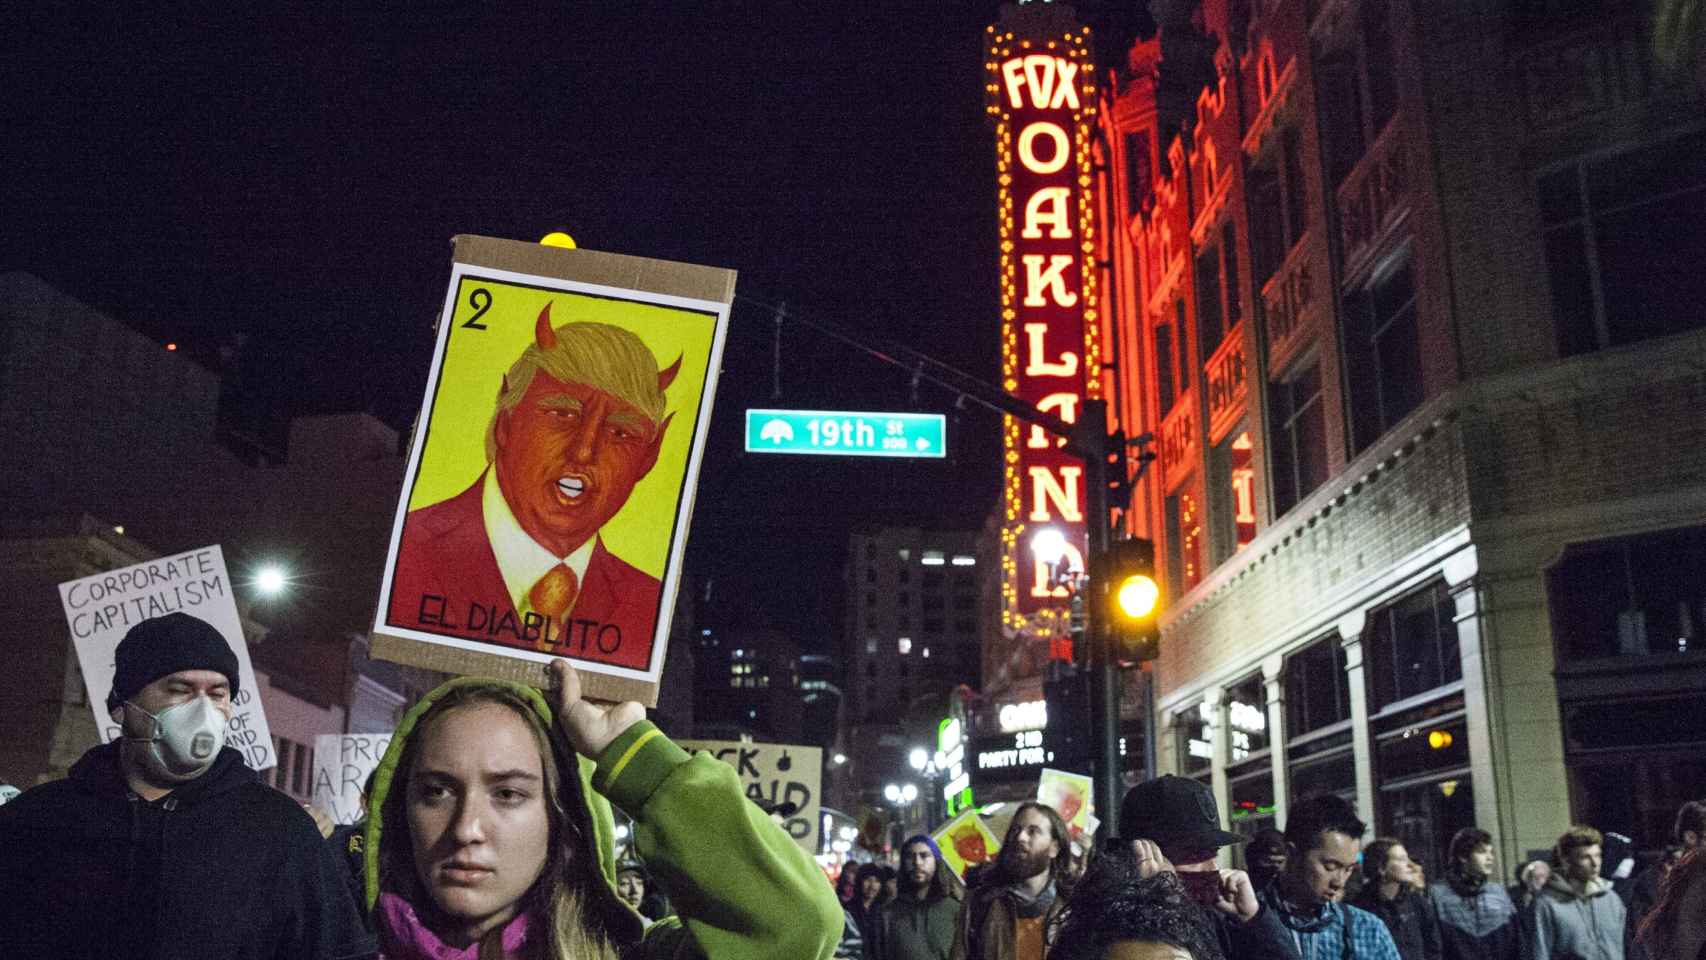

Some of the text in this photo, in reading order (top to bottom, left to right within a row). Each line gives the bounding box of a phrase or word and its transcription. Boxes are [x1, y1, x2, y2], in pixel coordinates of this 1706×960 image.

[1002, 54, 1080, 109] FOX
[461, 288, 492, 331] 2
[806, 419, 875, 447] 19th
[68, 551, 215, 609] CORPORATE
[73, 575, 224, 638] CAPITALISM
[418, 594, 622, 654] EL DIABLITO
[229, 712, 251, 731] OF
[979, 749, 1018, 768] PARTY
